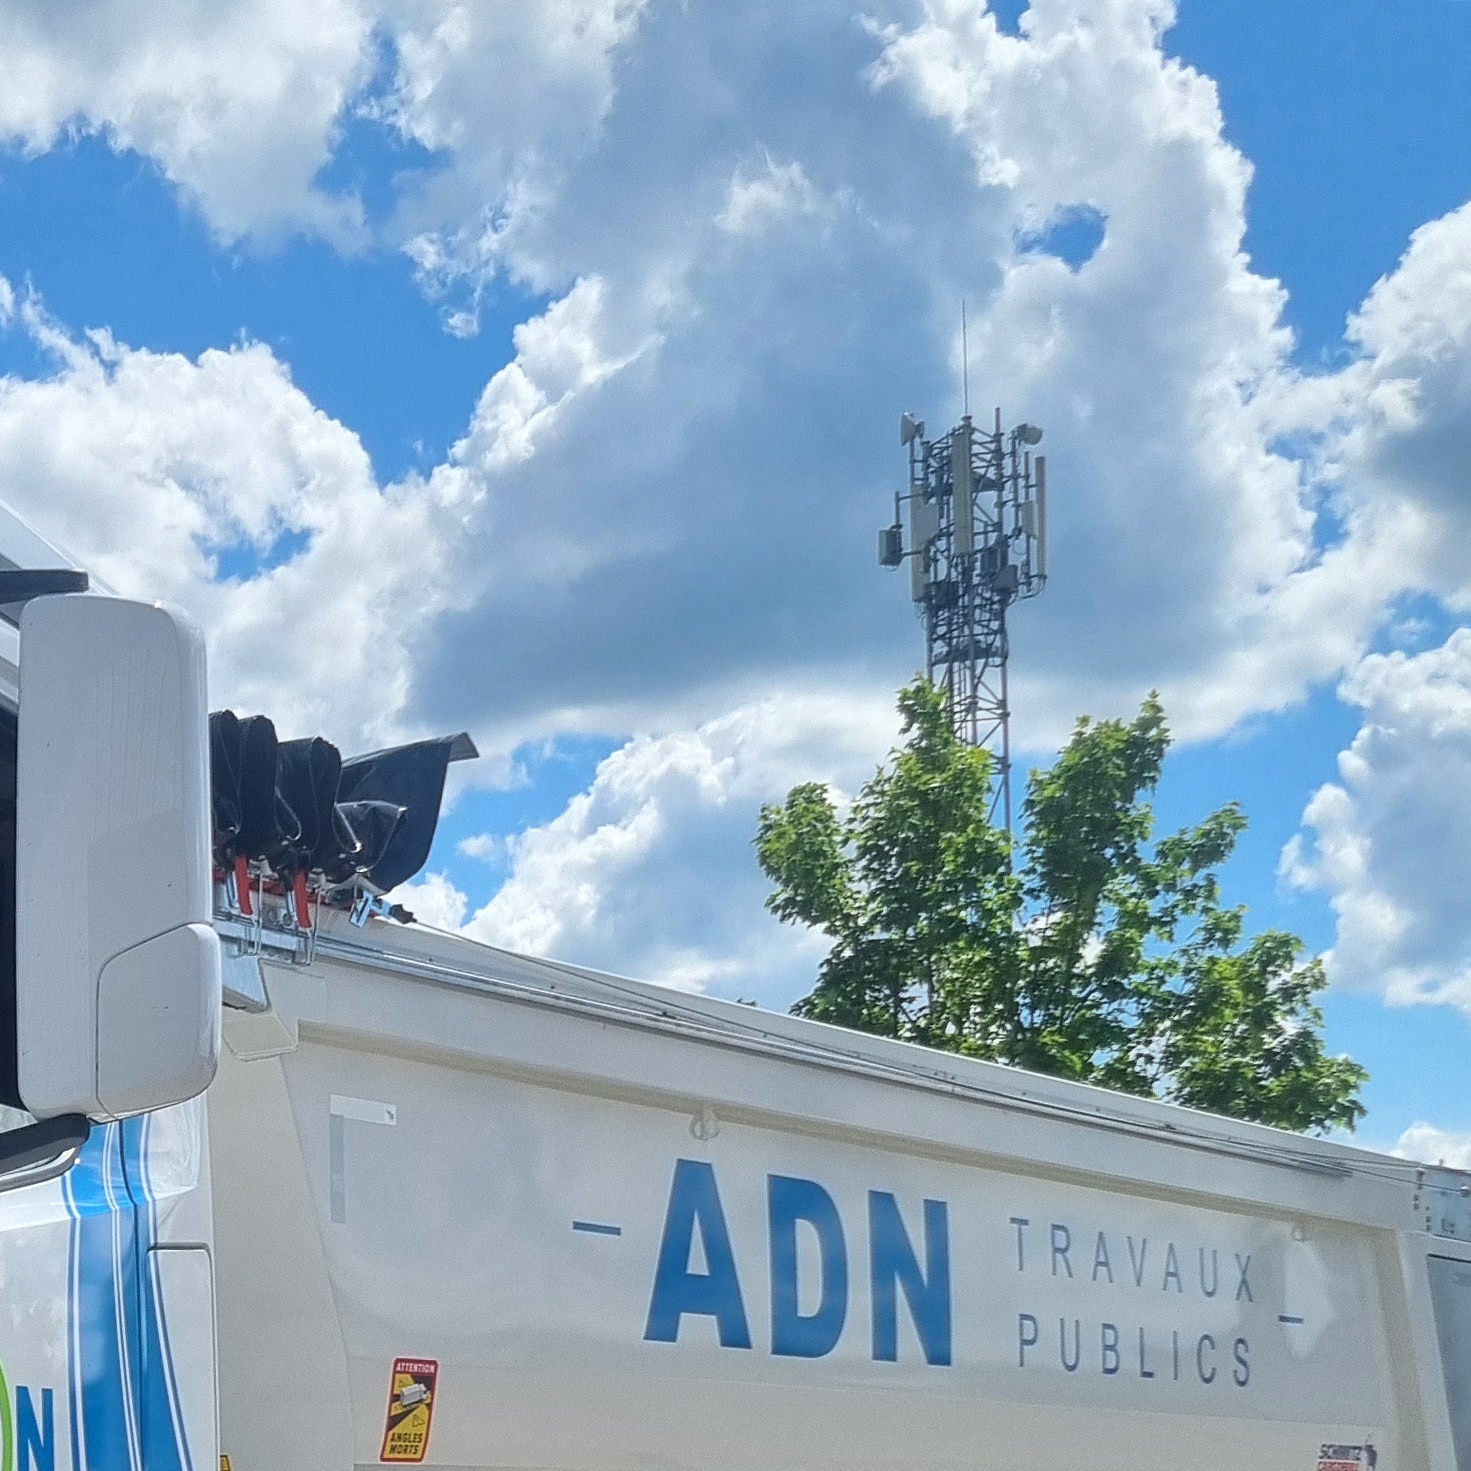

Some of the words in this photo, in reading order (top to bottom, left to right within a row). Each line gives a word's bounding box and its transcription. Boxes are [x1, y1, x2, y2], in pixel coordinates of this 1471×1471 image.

[643, 1158, 953, 1367] ADN
[1009, 1217, 1254, 1302] TRAVAUX
[395, 1362, 435, 1374] ATTENTION
[1019, 1313, 1250, 1387] PUBLICS
[389, 1444, 419, 1455] MORTS
[390, 1432, 423, 1444] ANGLES
